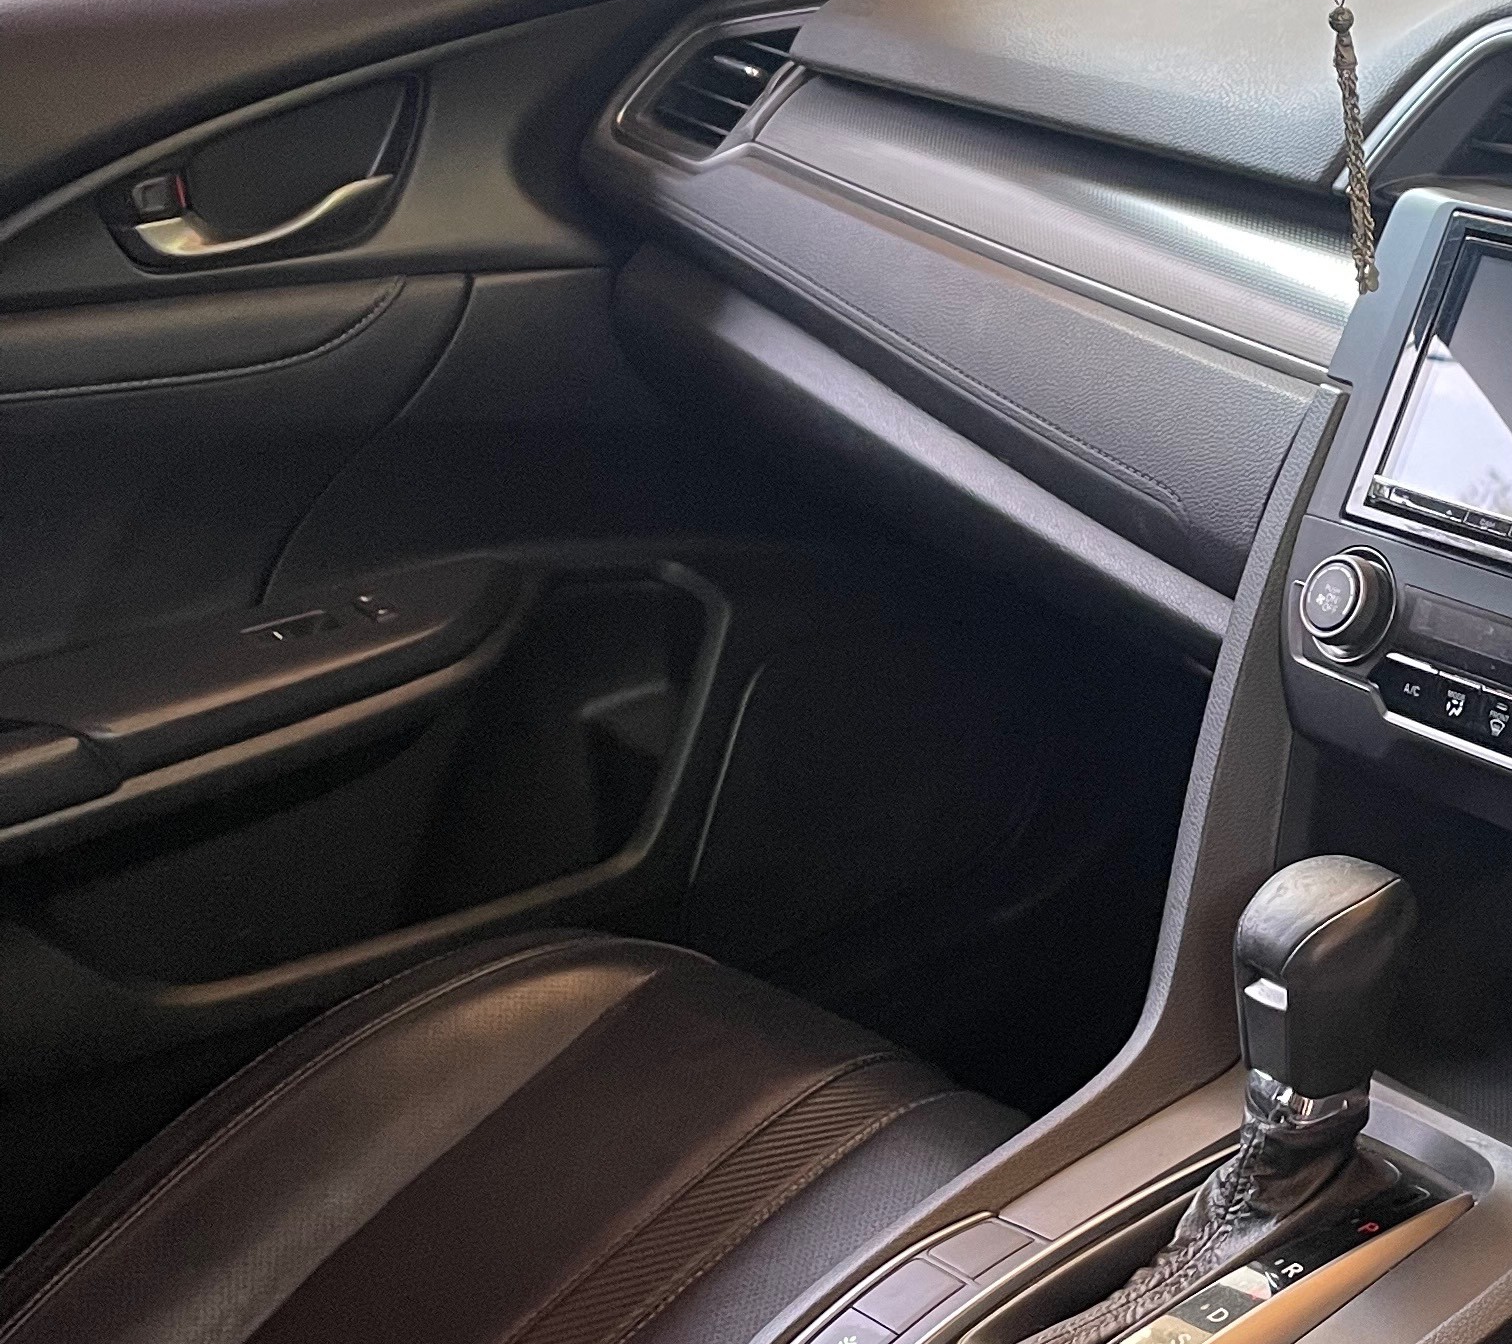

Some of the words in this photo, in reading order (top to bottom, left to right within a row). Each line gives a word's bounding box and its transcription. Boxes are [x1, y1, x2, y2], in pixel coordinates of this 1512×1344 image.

[1403, 682, 1421, 697] A/C
[1357, 1221, 1380, 1234] P
[1281, 1262, 1304, 1278] R
[1206, 1307, 1229, 1323] D
